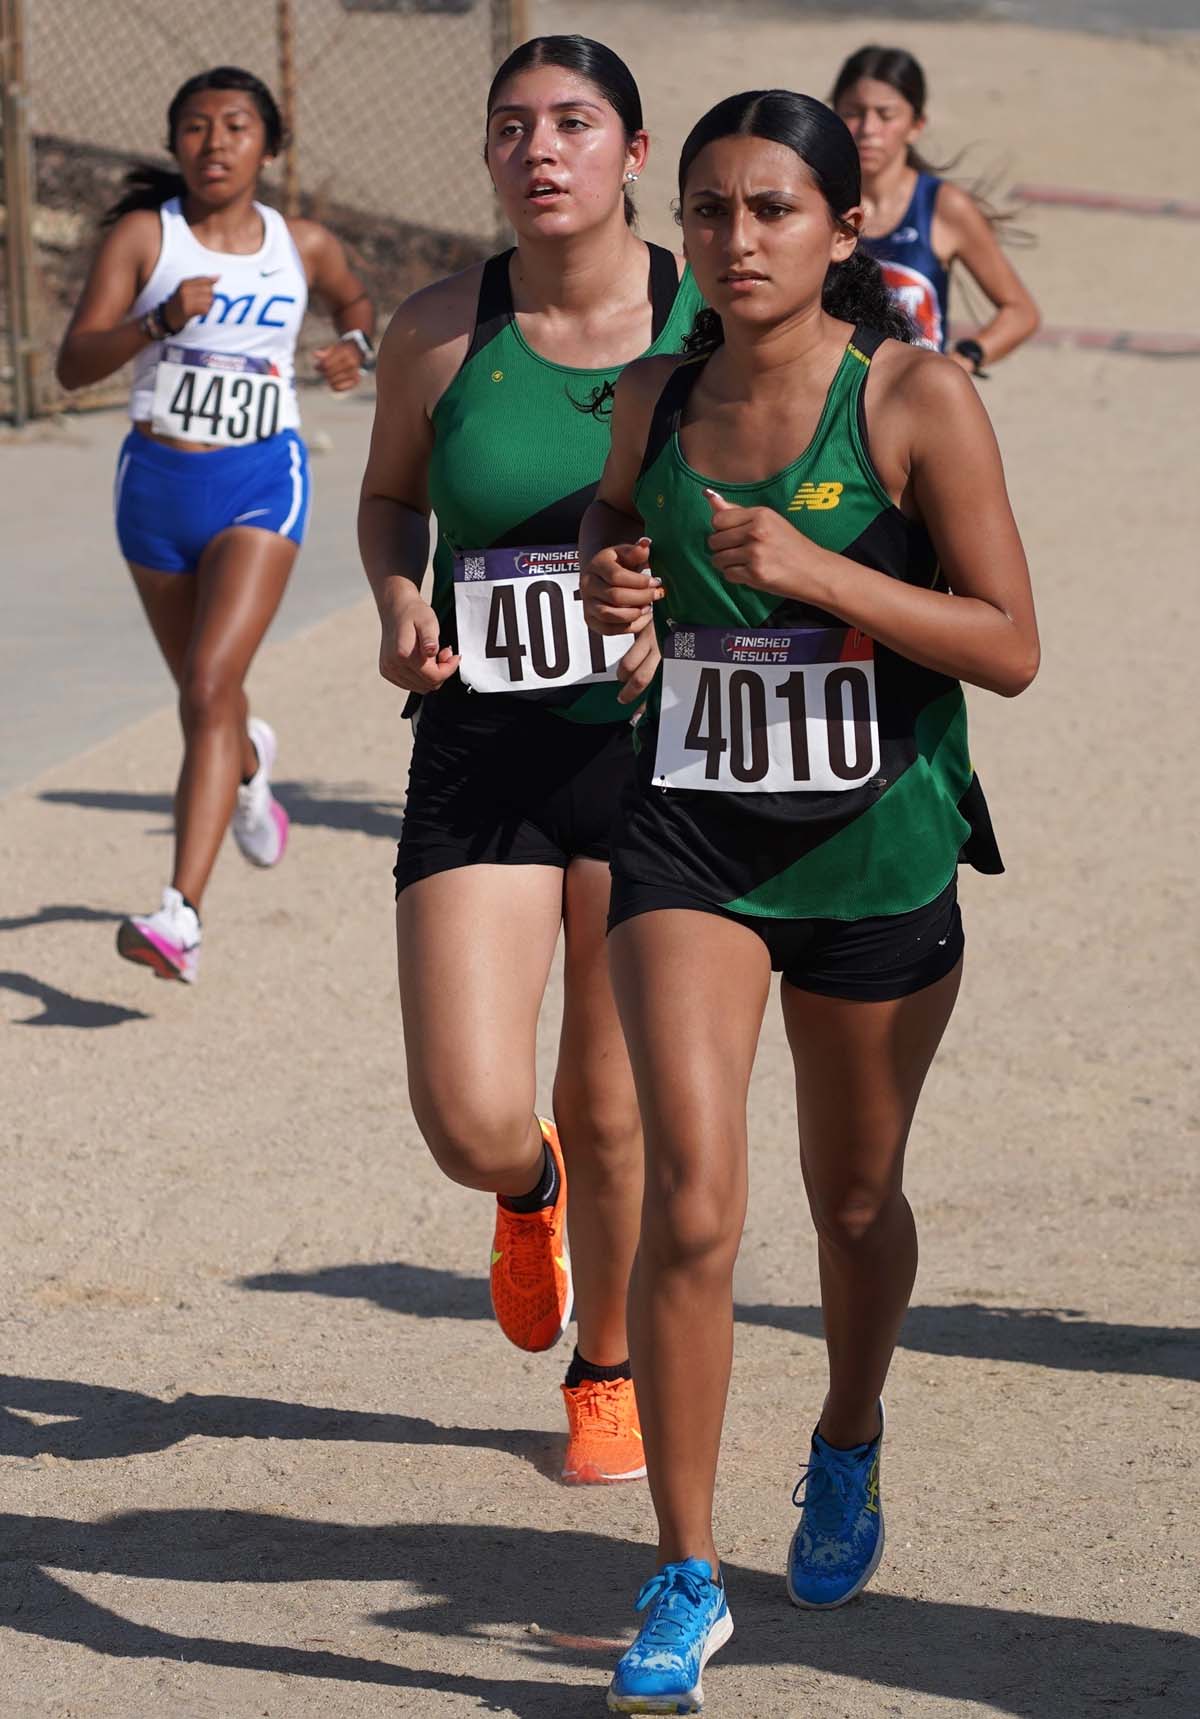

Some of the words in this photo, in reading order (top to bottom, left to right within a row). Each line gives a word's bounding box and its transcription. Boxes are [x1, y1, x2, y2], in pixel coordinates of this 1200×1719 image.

[169, 371, 280, 441] 4430
[528, 562, 580, 575] RESULTS
[485, 579, 640, 682] 401
[734, 636, 791, 648] FINISHED
[732, 650, 789, 662] RESULTS
[684, 666, 873, 783] 4010
